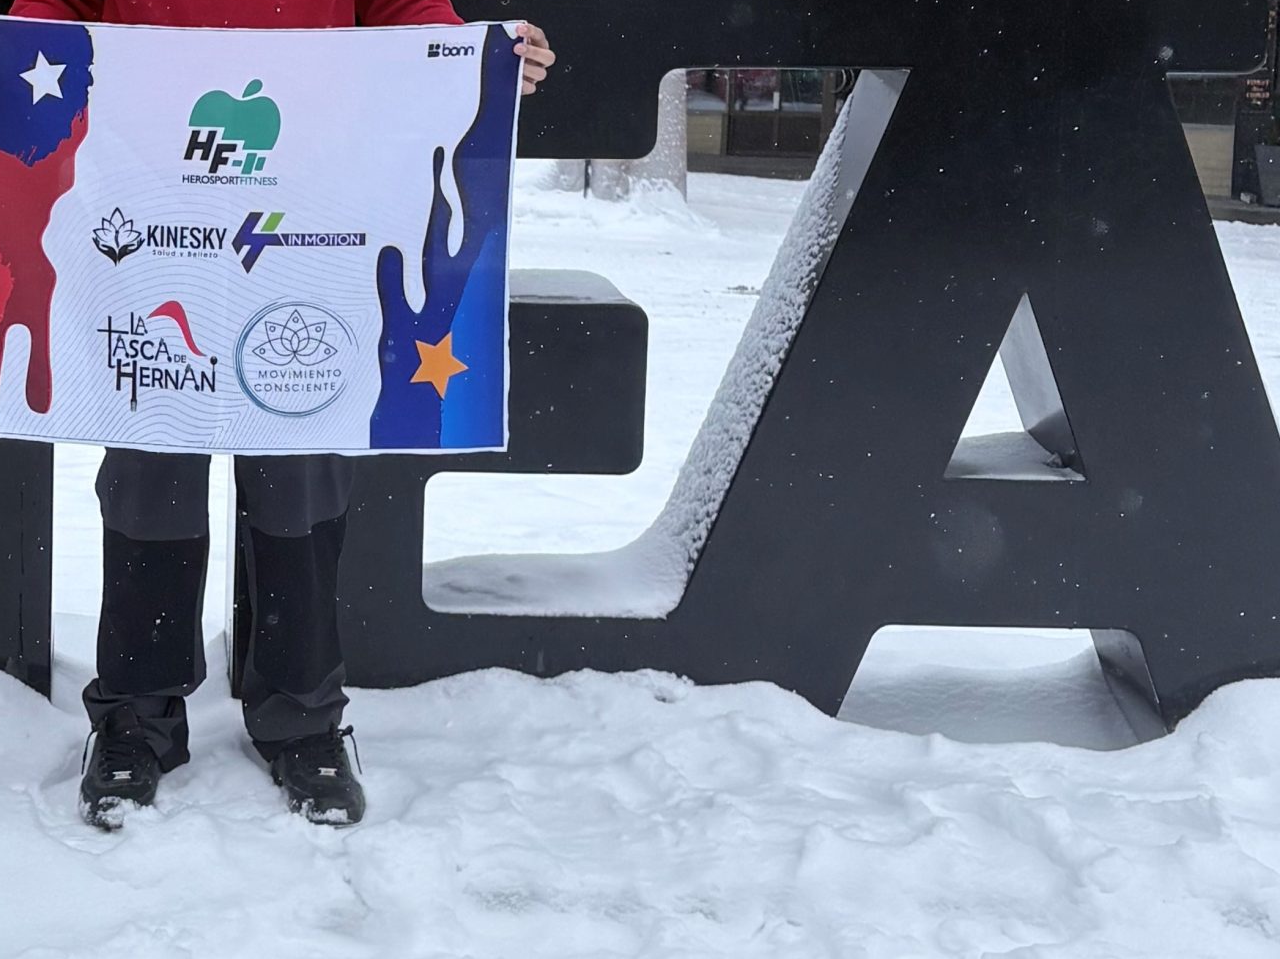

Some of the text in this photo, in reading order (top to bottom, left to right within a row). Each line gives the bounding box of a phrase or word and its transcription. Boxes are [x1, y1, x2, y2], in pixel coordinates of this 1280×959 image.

[442, 43, 475, 57] bonn
[182, 174, 278, 186] HEROSPORTFITNESS
[147, 225, 227, 250] KINESKY
[288, 234, 360, 246] IN MOTION
[130, 312, 148, 336] LA
[97, 315, 187, 369] TASCA DE
[258, 369, 342, 379] MOVIMIENTO
[253, 382, 336, 392] CONSCIENTE
